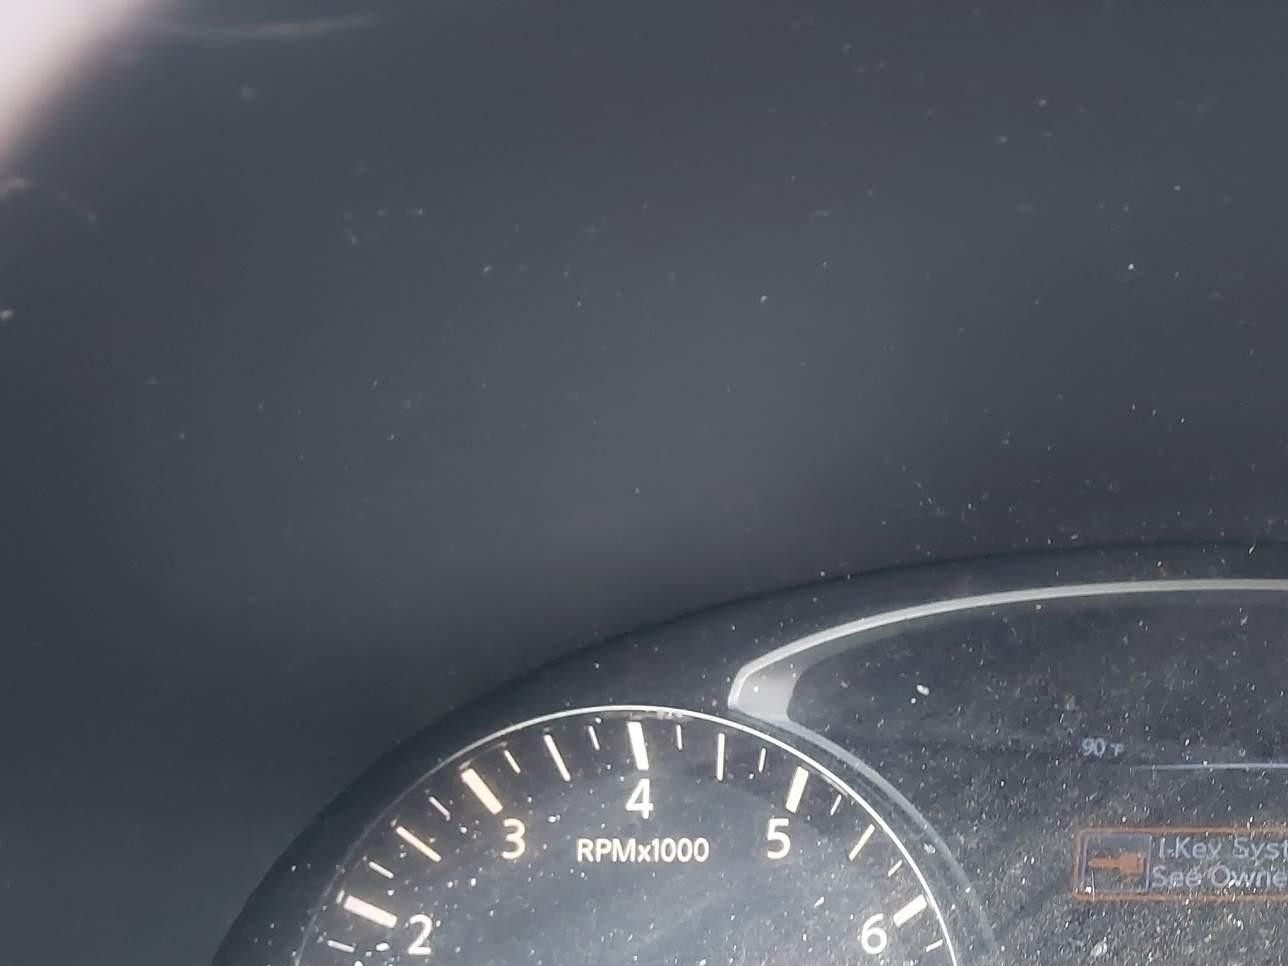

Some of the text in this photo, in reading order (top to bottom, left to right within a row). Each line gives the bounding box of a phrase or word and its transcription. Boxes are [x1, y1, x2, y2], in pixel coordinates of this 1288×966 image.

[1082, 737, 1105, 757] 90
[625, 778, 653, 818] 4
[501, 819, 525, 858] 3
[576, 838, 709, 864] RPMx1000
[766, 819, 790, 858] 5
[1152, 865, 1200, 888] See
[409, 915, 431, 954] 2
[860, 914, 887, 953] 6
